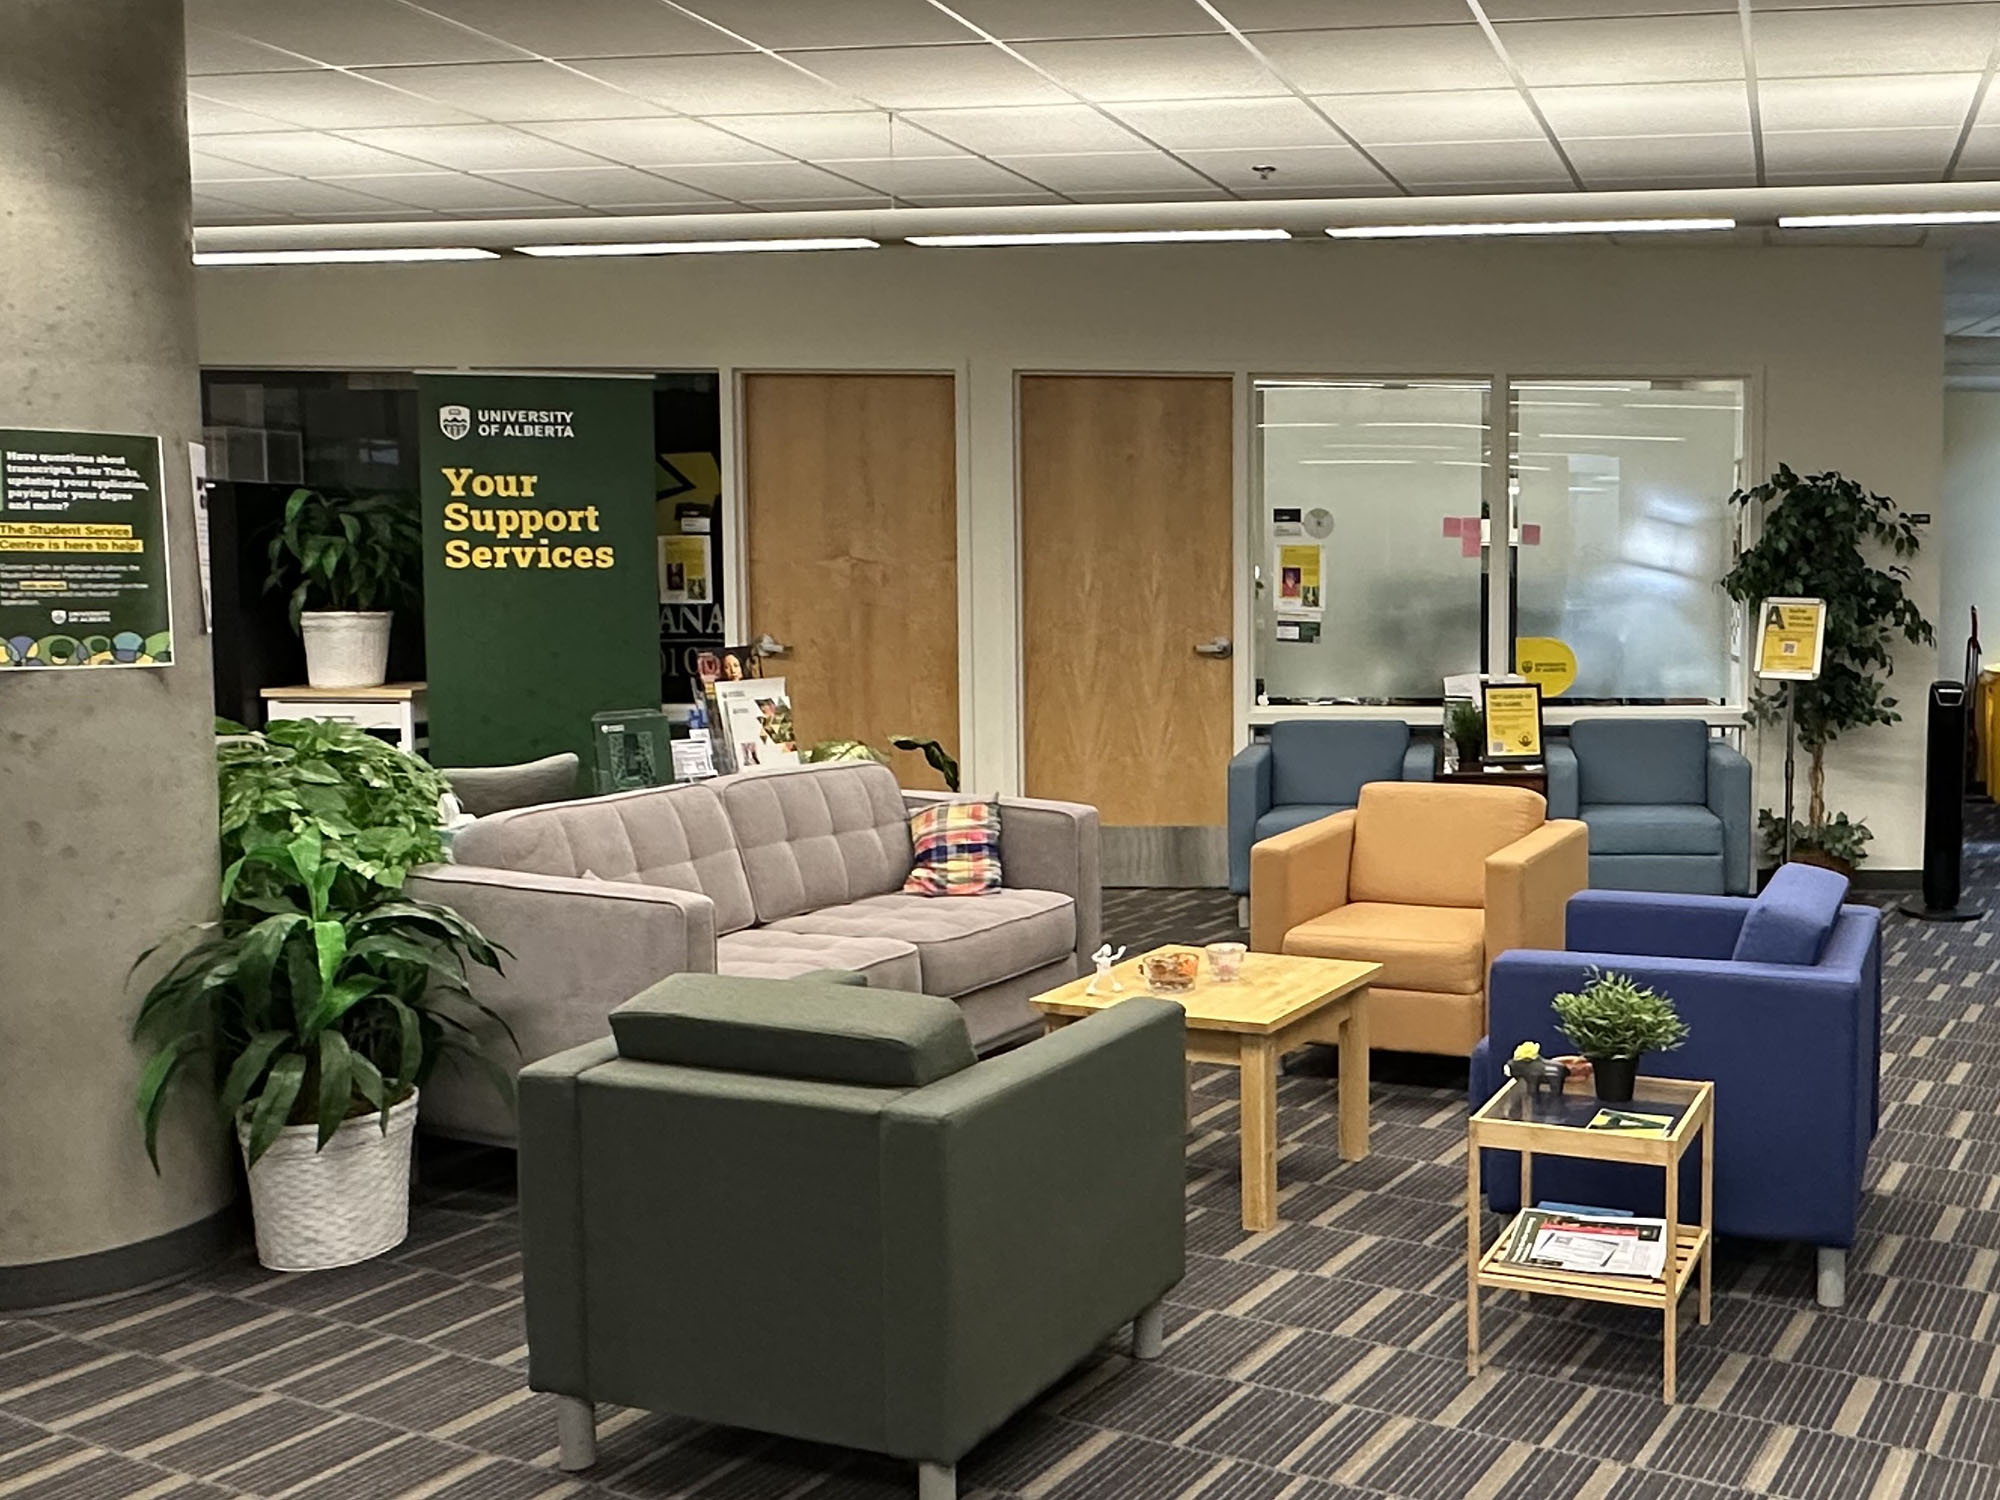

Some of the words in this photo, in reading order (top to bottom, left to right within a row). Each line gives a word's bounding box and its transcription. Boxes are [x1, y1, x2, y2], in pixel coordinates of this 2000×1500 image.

[477, 409, 575, 424] UNIVERSITY
[478, 424, 500, 437] OF
[503, 424, 575, 438] ALBERTA
[6, 451, 37, 461] Have
[39, 453, 94, 463] questions
[96, 454, 125, 464] about
[62, 479, 89, 488] your
[441, 467, 538, 497] Your
[8, 489, 49, 500] paying
[51, 489, 68, 499] for
[69, 491, 97, 500] your
[8, 501, 31, 510] and
[443, 502, 600, 539] Support
[1, 525, 25, 535] The
[28, 525, 80, 535] Student
[85, 526, 130, 536] Service
[0, 540, 45, 549] Centre
[48, 541, 60, 549] is
[63, 541, 94, 550] here
[96, 541, 108, 550] to
[111, 541, 140, 551] help!
[445, 538, 615, 569] Services
